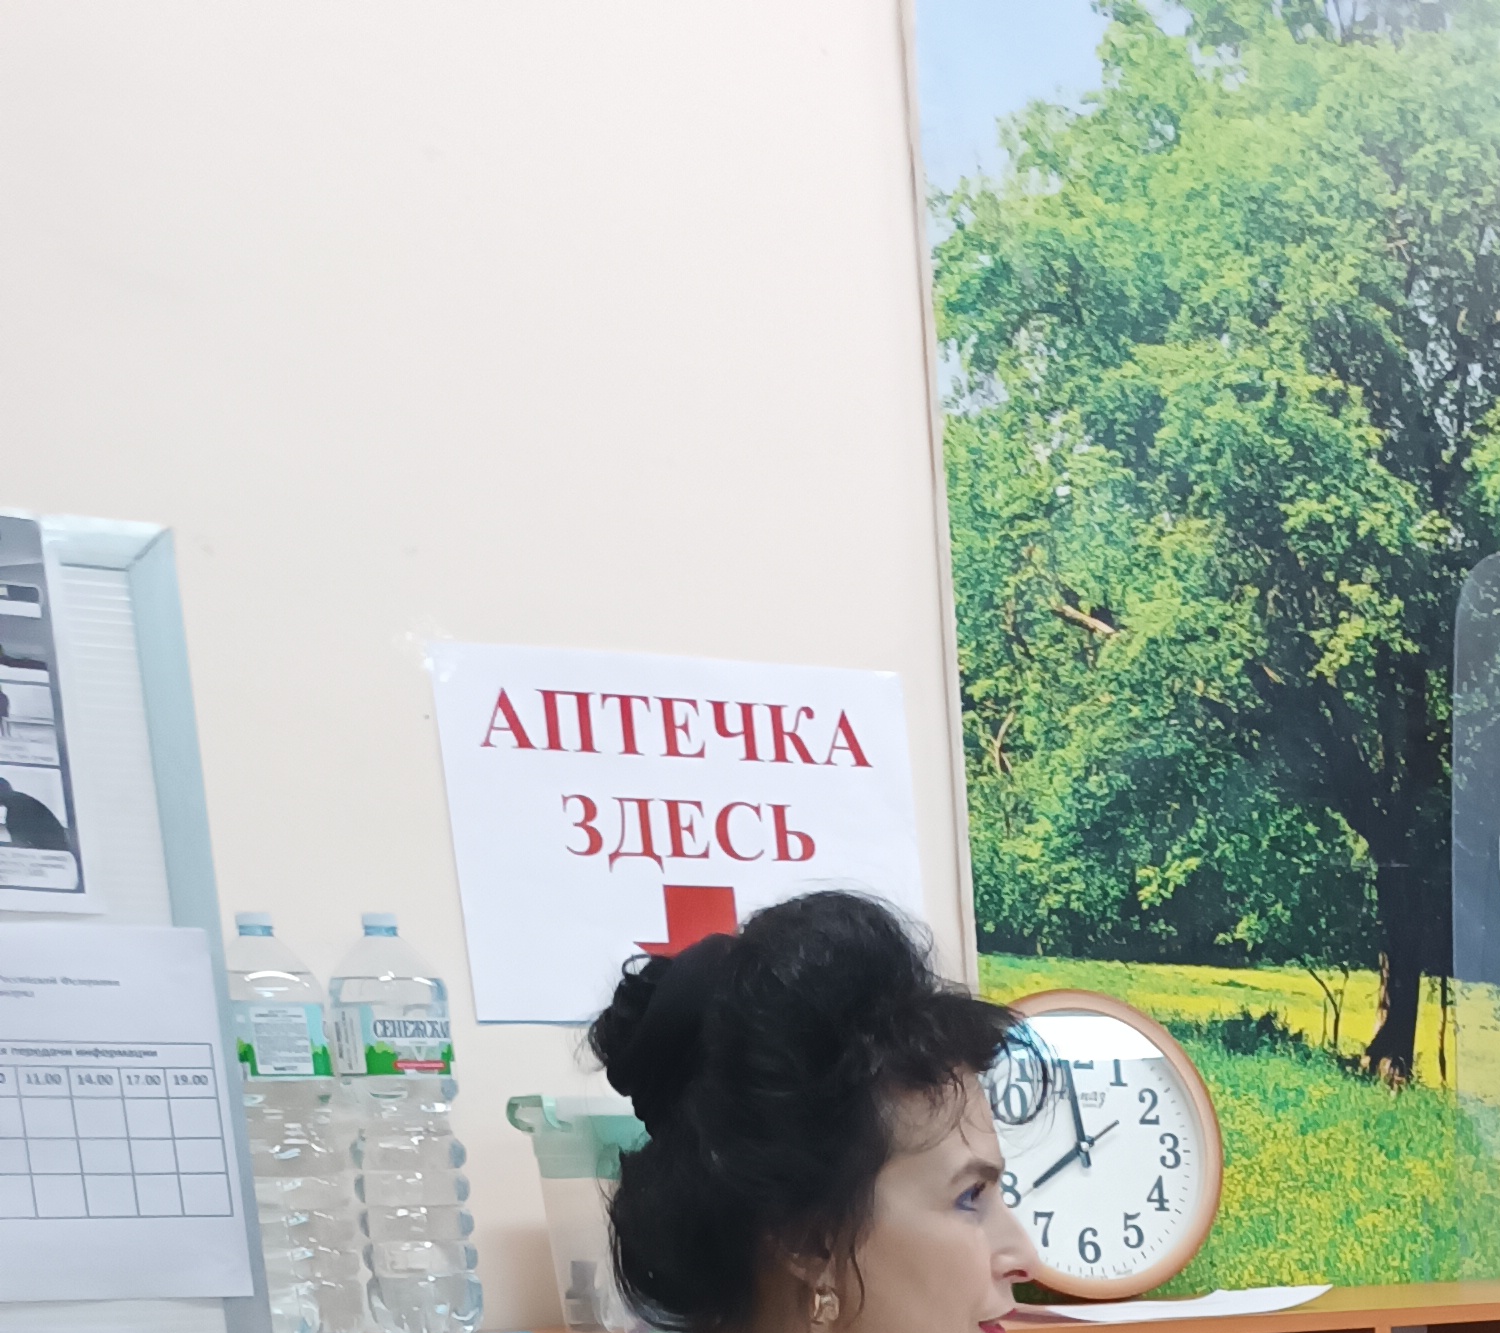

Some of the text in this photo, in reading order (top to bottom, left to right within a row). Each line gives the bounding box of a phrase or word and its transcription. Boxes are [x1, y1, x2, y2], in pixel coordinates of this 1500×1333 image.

[480, 687, 873, 768] АПТЕЧКА
[561, 793, 816, 874] ЗДЕСЬ
[1138, 1088, 1160, 1125] 2
[1159, 1133, 1181, 1169] 3
[1001, 1171, 1021, 1209] 8
[1146, 1175, 1170, 1212] 4
[1033, 1210, 1054, 1248] 7
[1078, 1227, 1101, 1264] 6
[1122, 1212, 1145, 1249] 5
